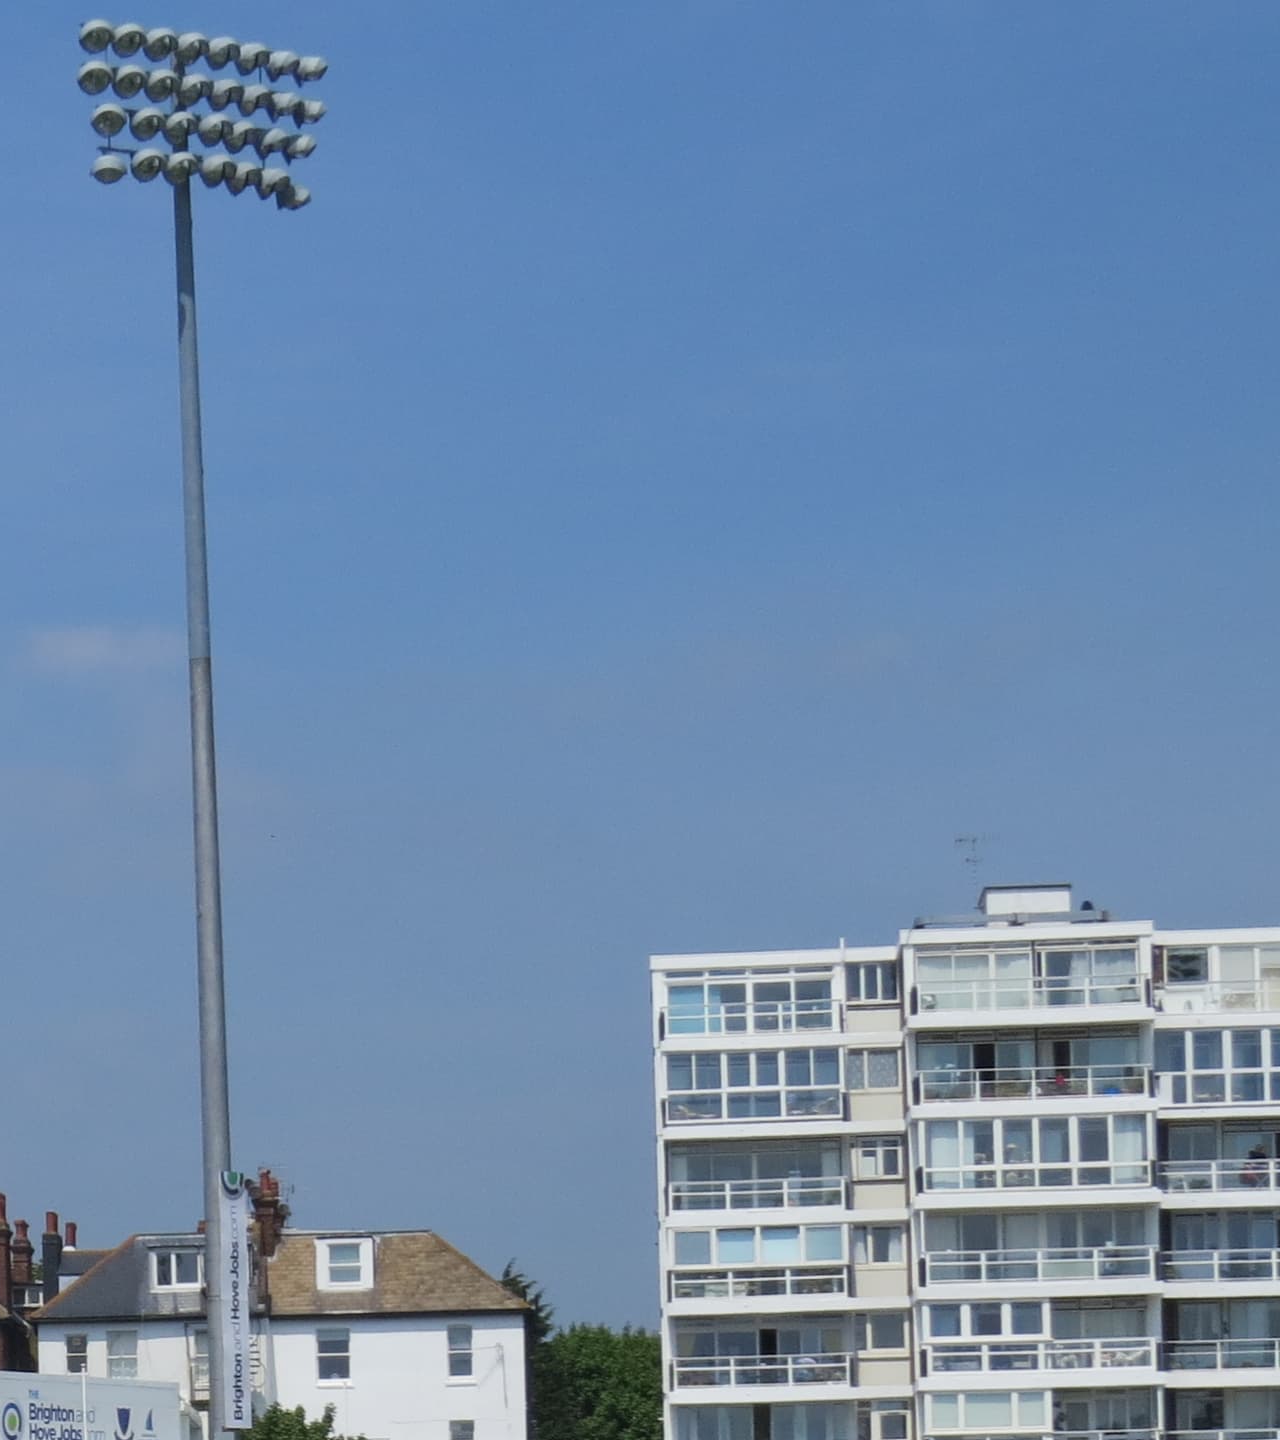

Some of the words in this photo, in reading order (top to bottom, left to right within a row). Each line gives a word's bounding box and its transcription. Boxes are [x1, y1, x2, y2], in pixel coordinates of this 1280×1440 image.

[233, 1353, 243, 1420] Brighton
[29, 1403, 75, 1424] Brighton
[76, 1405, 96, 1424] ad
